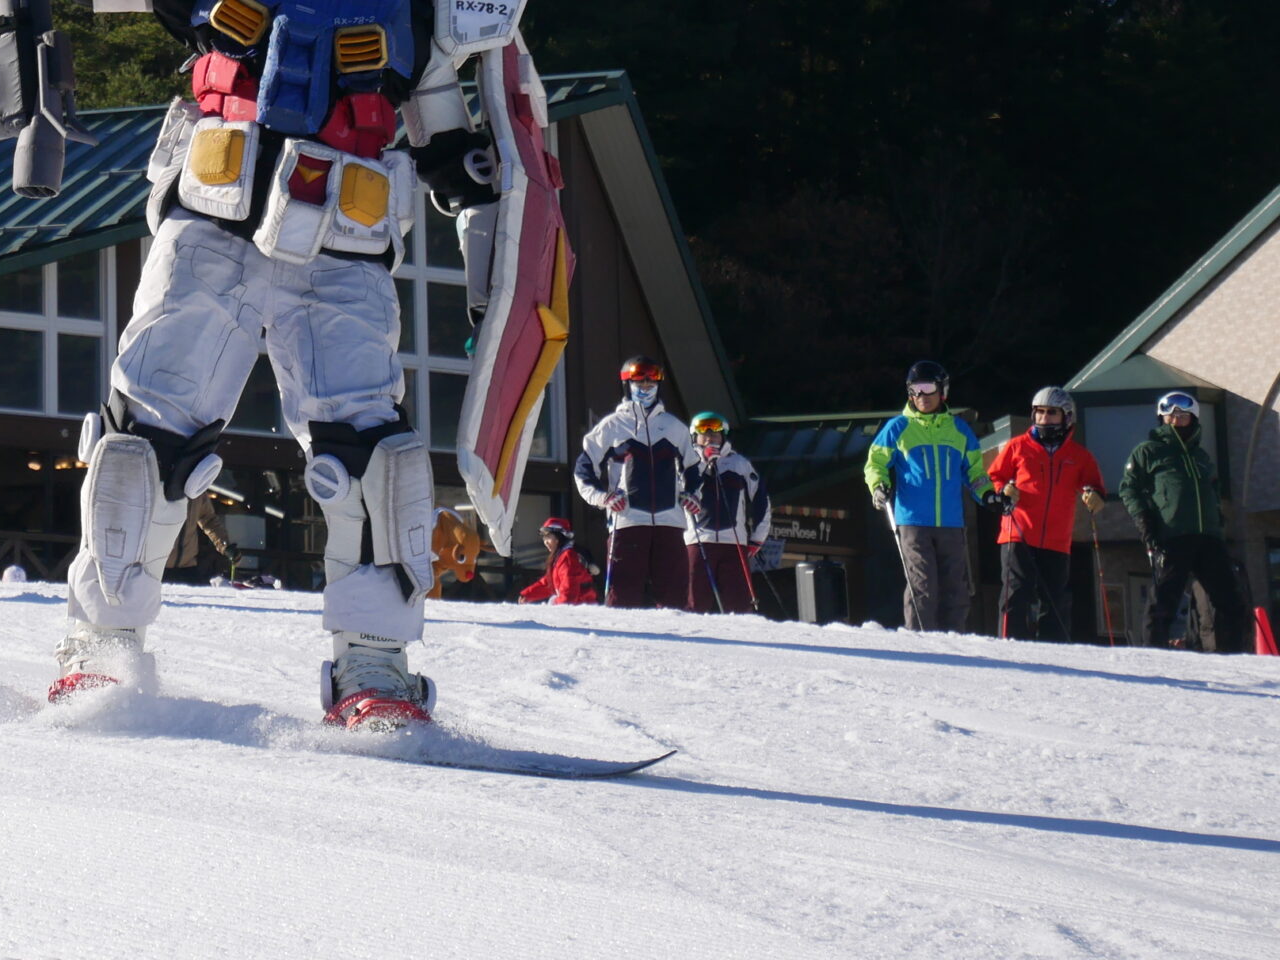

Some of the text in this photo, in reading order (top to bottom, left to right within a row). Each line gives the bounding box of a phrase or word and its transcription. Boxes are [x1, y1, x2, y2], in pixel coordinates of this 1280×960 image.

[456, 0, 508, 16] RX-78-2
[334, 15, 376, 25] RX-78-2
[768, 521, 817, 540] lpenRose
